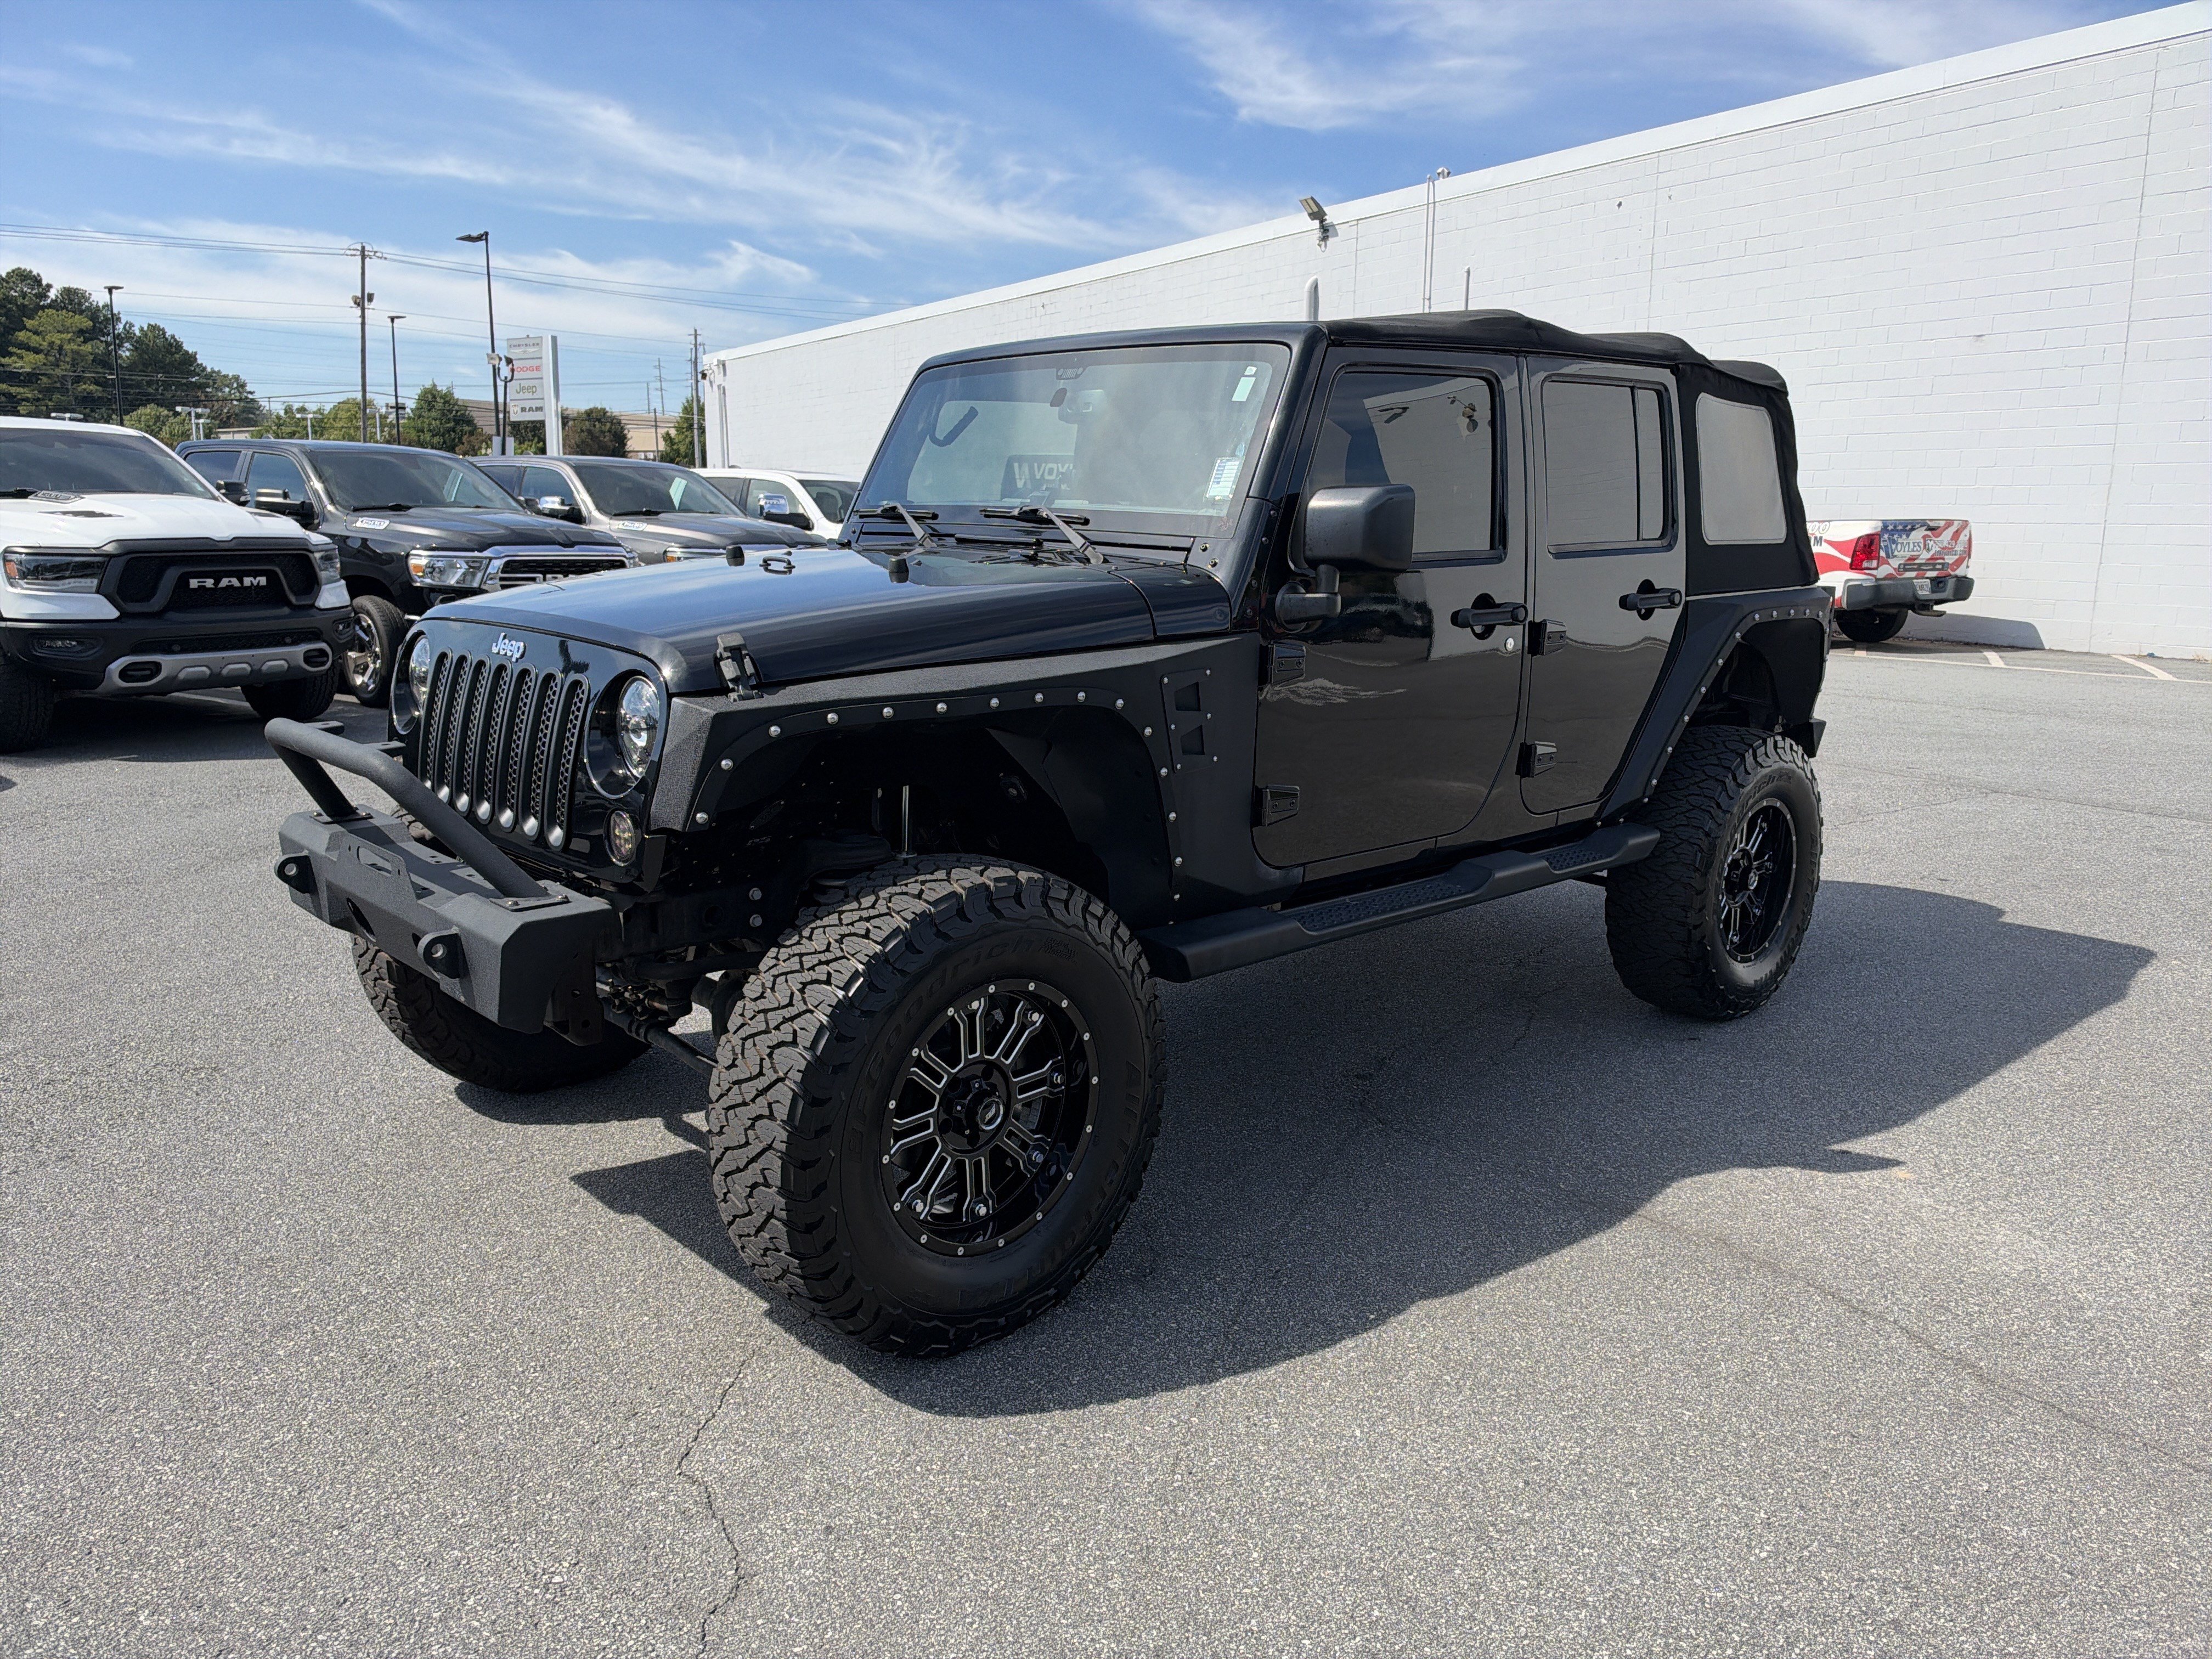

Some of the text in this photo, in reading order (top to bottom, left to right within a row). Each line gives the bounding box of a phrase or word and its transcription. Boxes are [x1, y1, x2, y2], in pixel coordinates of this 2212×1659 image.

[516, 383, 537, 395] Jeep
[189, 577, 267, 589] RAM
[492, 632, 524, 662] Jeep
